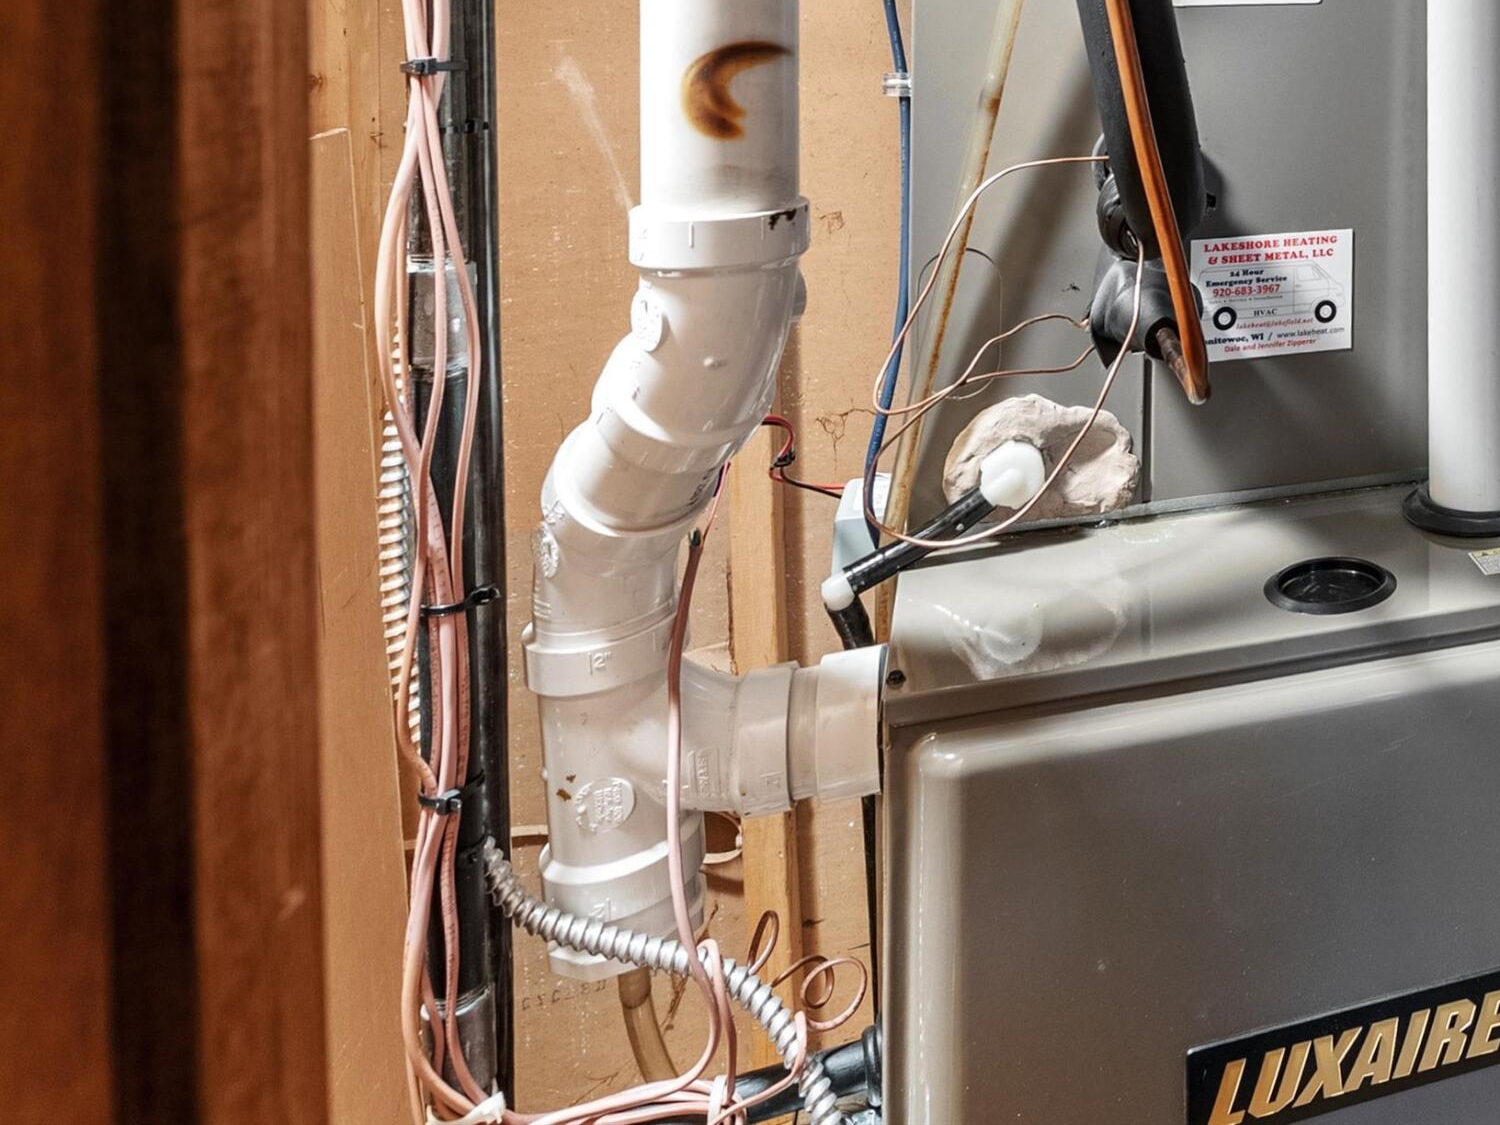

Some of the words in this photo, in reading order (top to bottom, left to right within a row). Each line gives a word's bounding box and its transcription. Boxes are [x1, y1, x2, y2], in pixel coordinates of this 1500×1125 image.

[1204, 240, 1279, 252] LAKESHORE
[1283, 236, 1338, 247] HEATING
[1208, 257, 1218, 265] &
[1222, 254, 1261, 264] SHEET
[1264, 251, 1309, 261] METAL,
[1312, 249, 1334, 257] LLC
[1206, 278, 1253, 288] Emergency
[1256, 276, 1287, 284] Service
[1213, 284, 1280, 297] 920-683-3967
[1205, 335, 1249, 345] nitowoc,
[1251, 333, 1264, 341] WI
[1277, 327, 1345, 338] www.lakeheat.com
[1225, 344, 1240, 353] Dale
[1243, 343, 1256, 351] and
[1258, 340, 1285, 350] Jennifer
